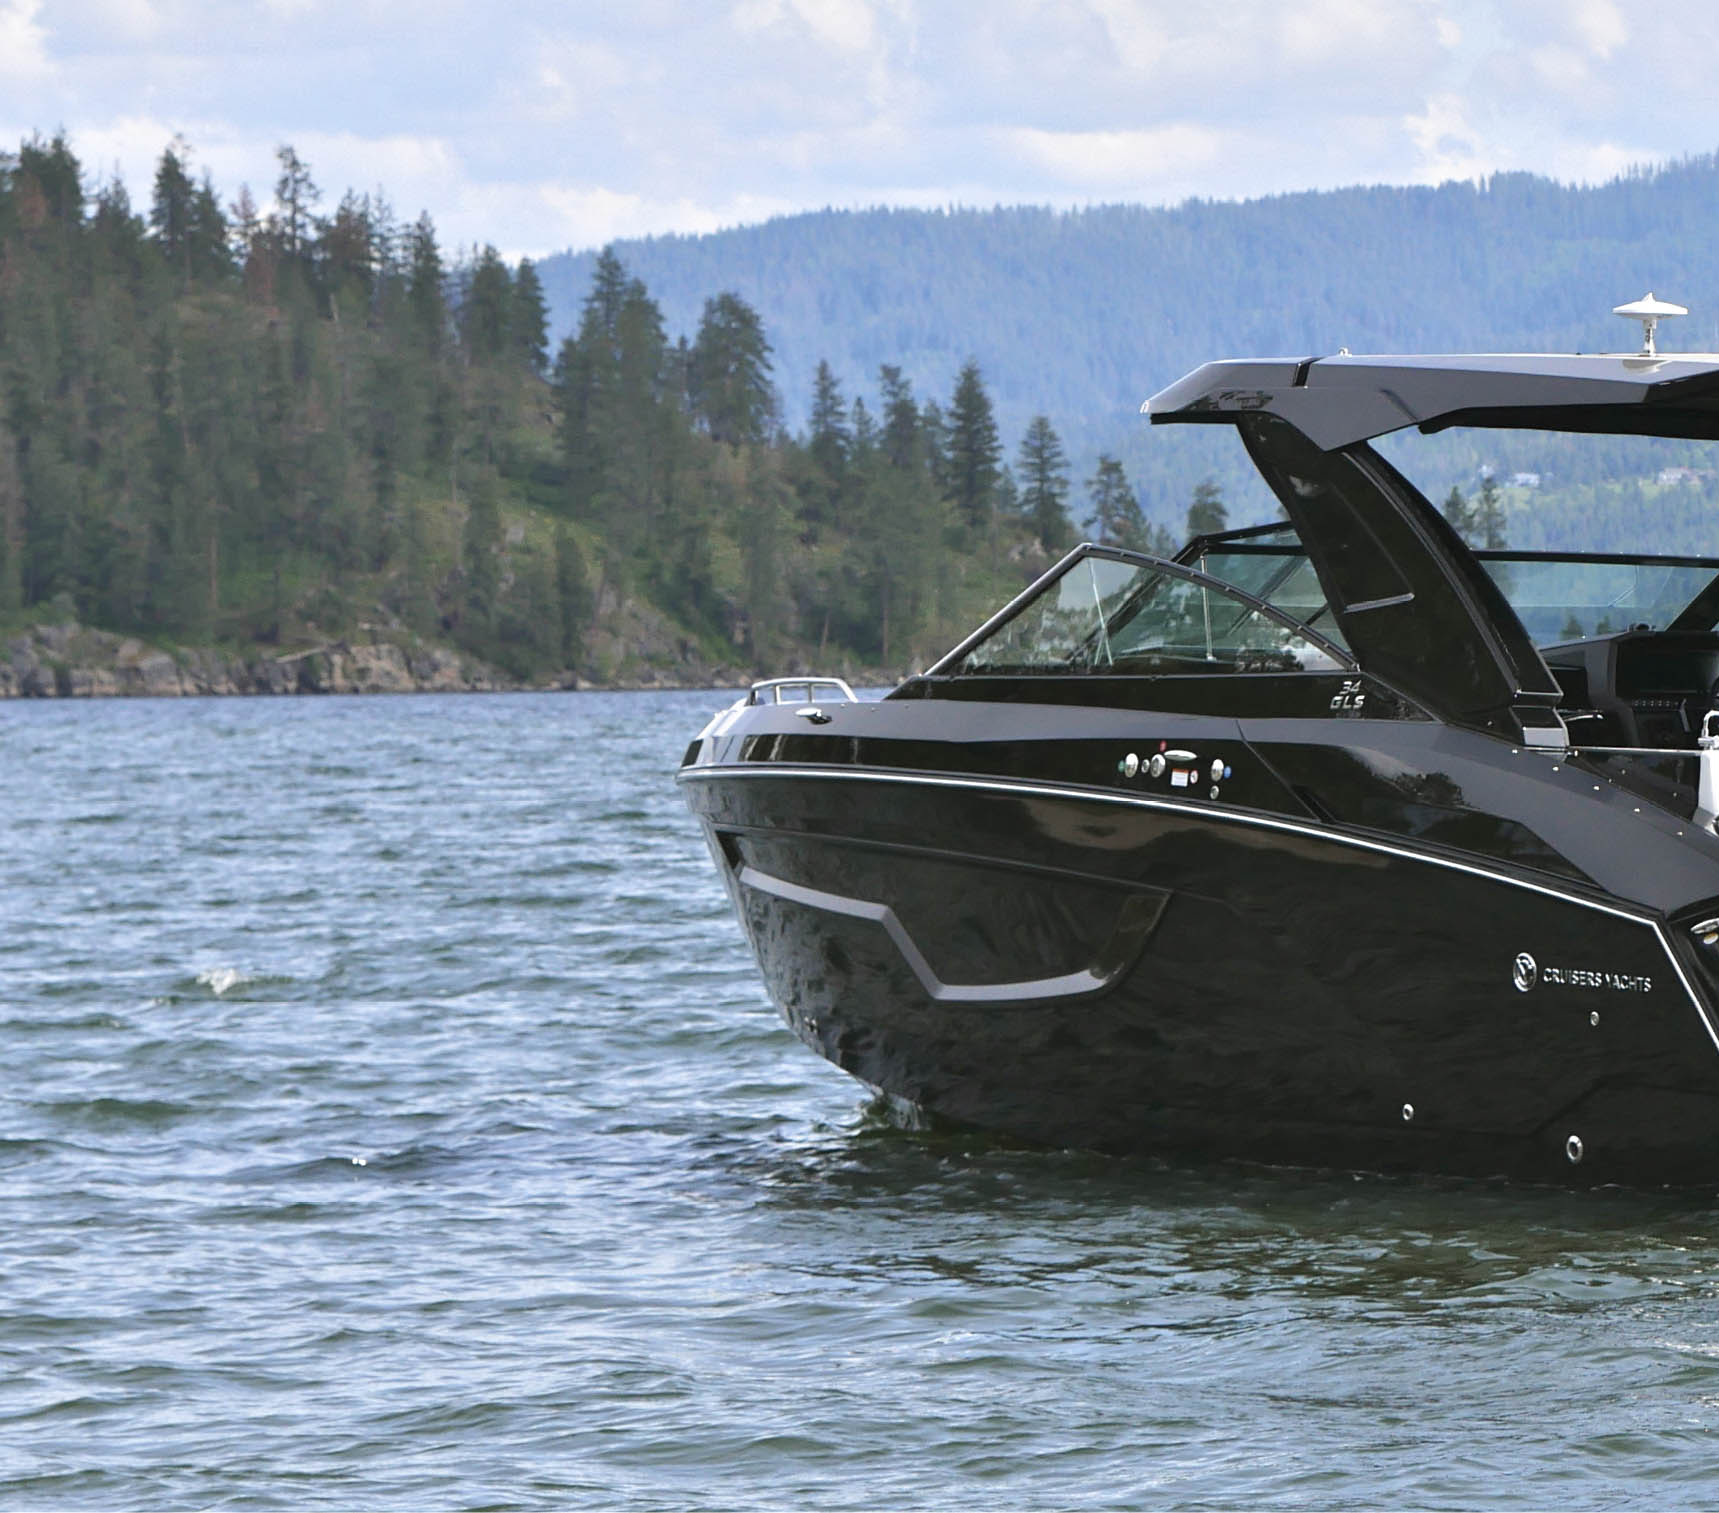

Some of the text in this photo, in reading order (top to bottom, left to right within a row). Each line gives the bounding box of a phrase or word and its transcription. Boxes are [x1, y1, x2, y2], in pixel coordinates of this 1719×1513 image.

[1339, 680, 1361, 695] 34
[1330, 695, 1365, 709] GLS
[1543, 967, 1652, 992] CRUISERS YACHTS
